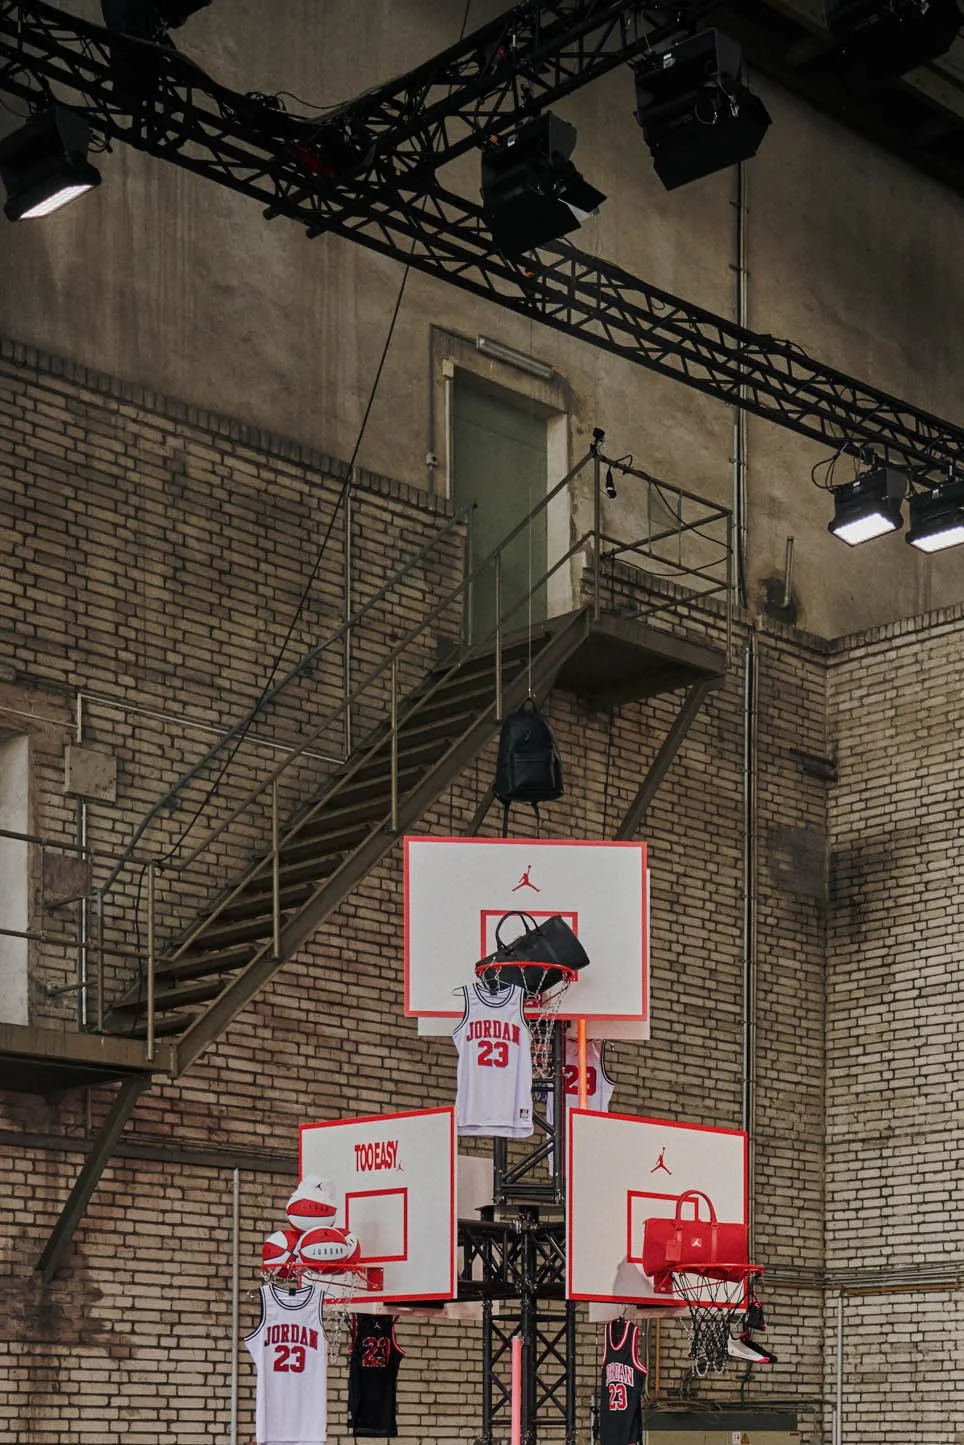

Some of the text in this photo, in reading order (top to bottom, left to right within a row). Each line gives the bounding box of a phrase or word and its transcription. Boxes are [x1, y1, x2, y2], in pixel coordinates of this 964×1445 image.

[466, 1020, 521, 1046] JORDAN
[477, 1040, 509, 1068] 23
[264, 1323, 319, 1350] JORDAN
[273, 1344, 306, 1373] 23
[606, 1362, 634, 1387] ORDAN
[608, 1383, 628, 1411] 23
